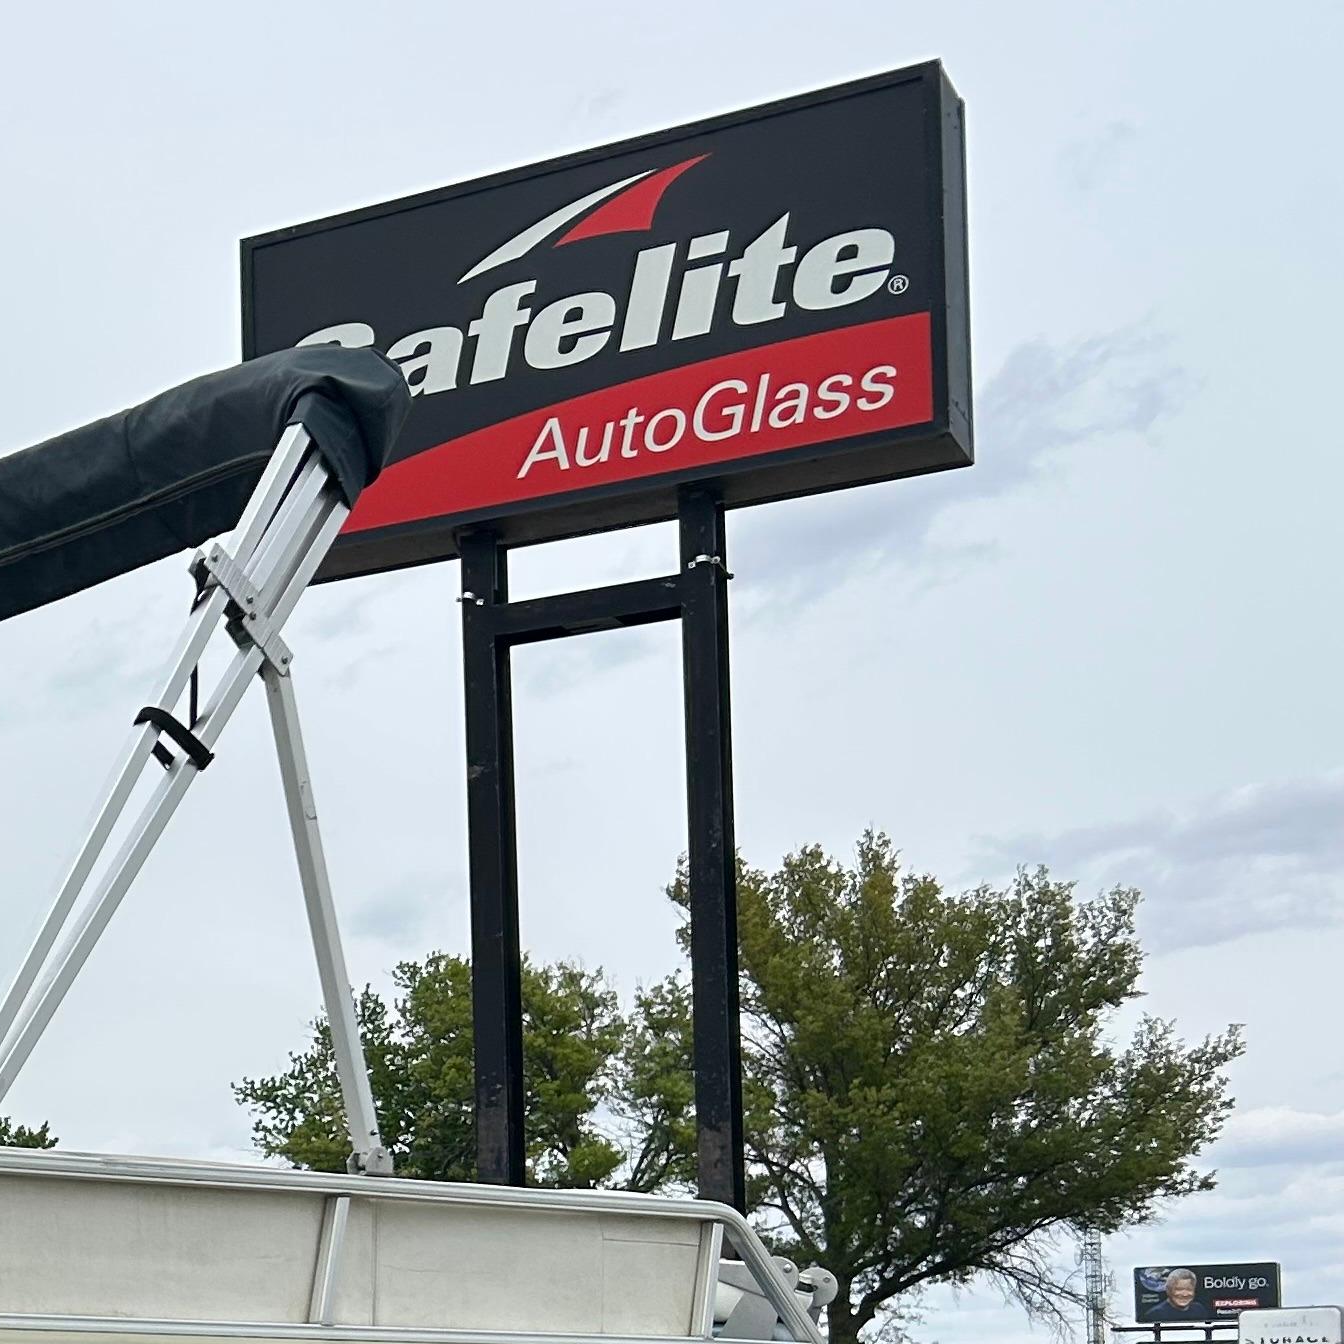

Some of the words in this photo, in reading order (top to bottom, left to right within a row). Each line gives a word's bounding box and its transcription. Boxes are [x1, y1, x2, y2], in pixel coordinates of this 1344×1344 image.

[515, 366, 897, 480] AutoGlass
[1204, 1276, 1246, 1290] Boldly
[1248, 1277, 1270, 1290] go.
